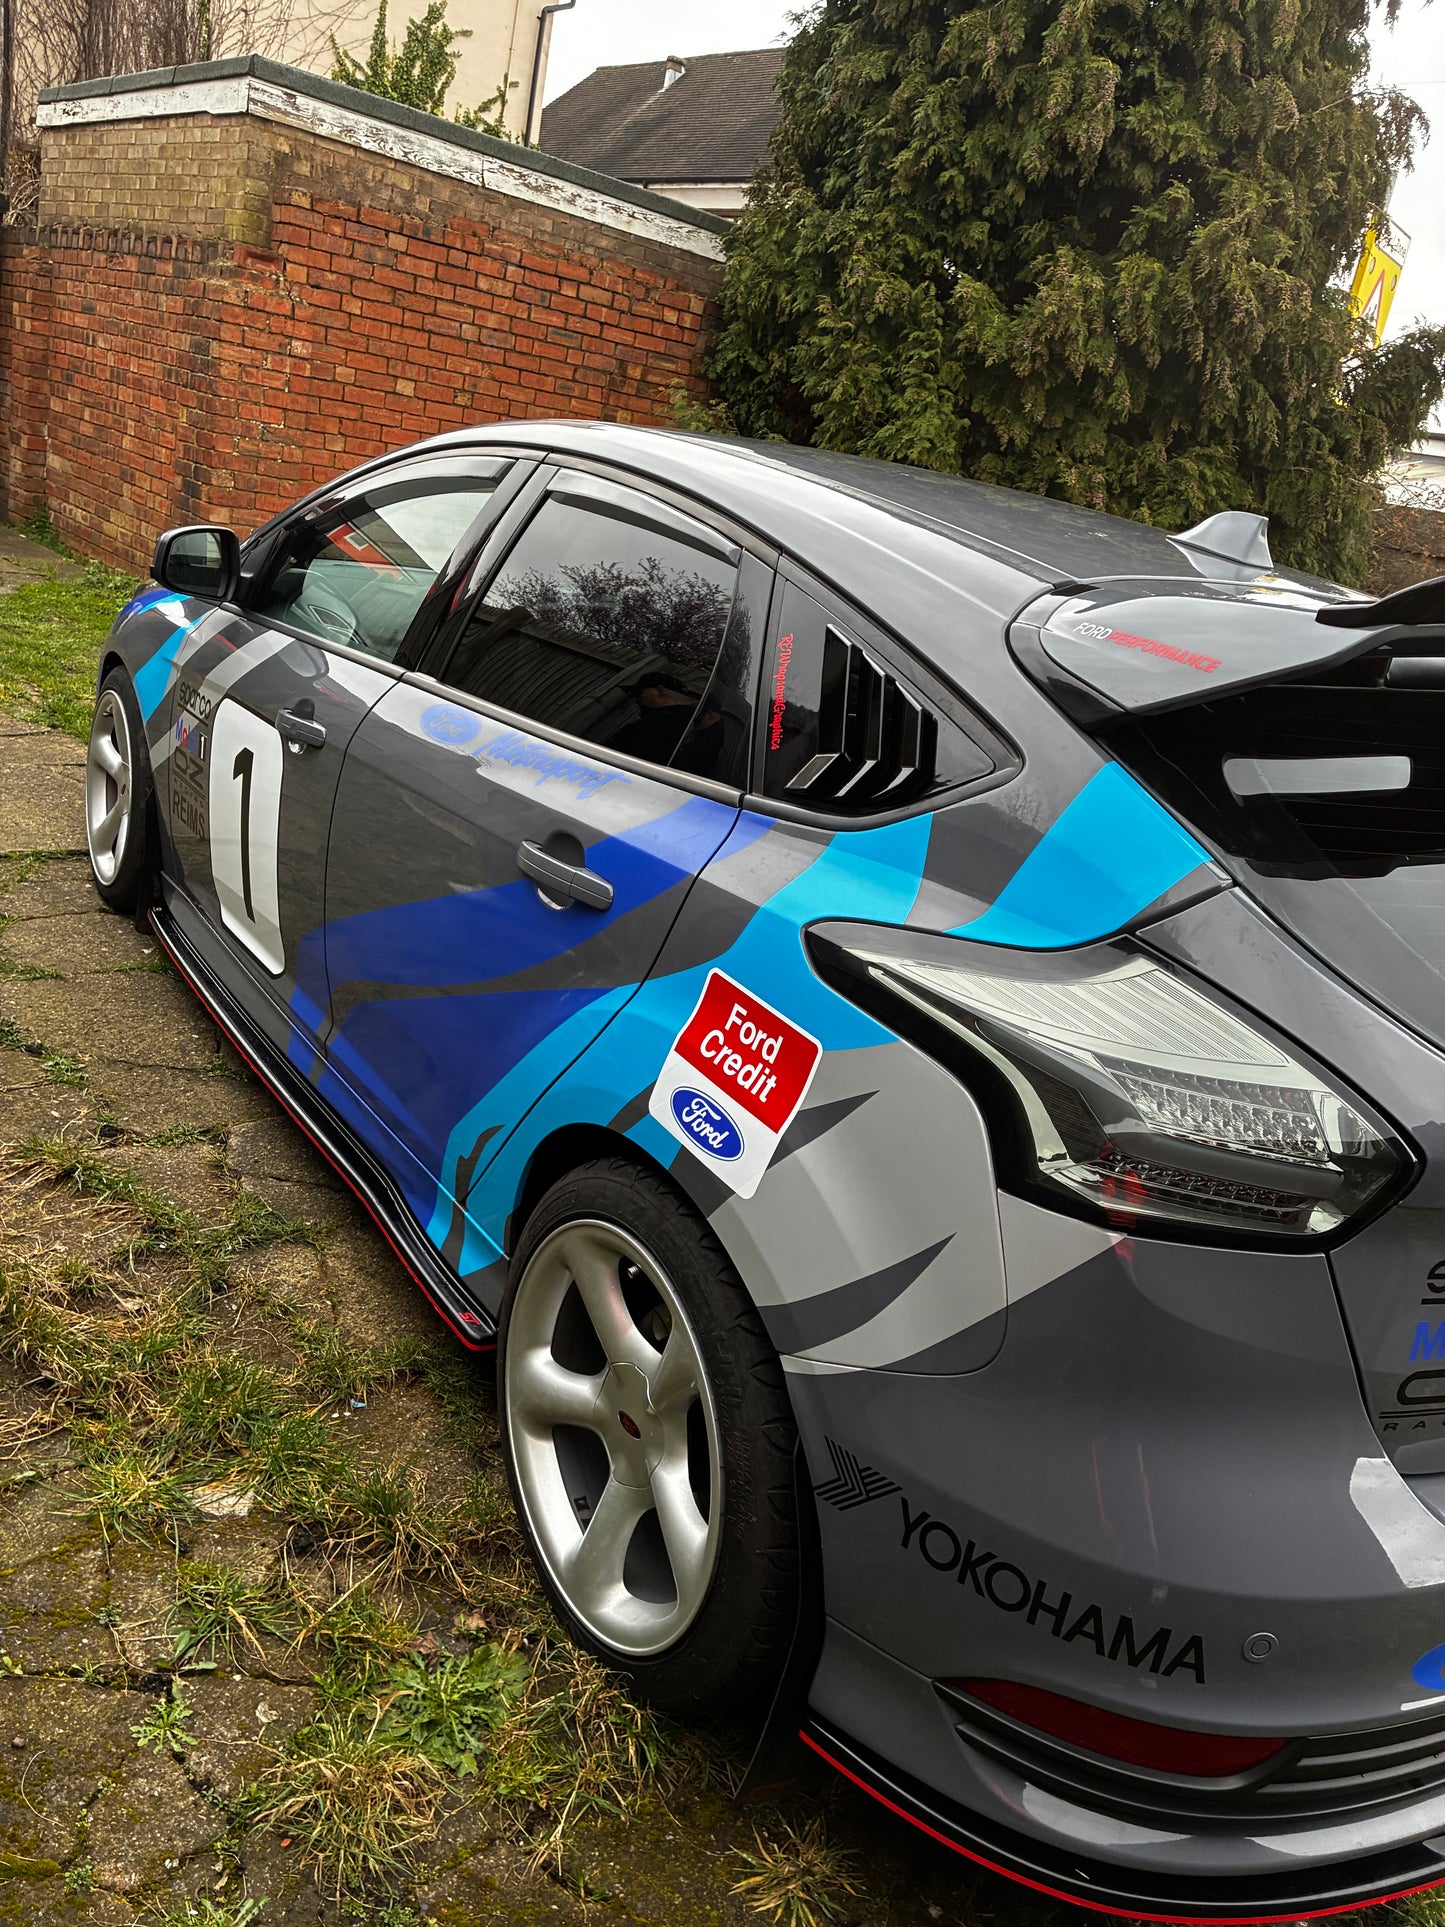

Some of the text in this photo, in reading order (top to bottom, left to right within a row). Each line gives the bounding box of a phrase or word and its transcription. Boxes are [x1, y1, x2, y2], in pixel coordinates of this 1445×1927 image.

[179, 682, 212, 720] sparco
[172, 791, 205, 839] REIMS
[233, 747, 256, 924] 1
[724, 1002, 784, 1064] Ford
[699, 1029, 778, 1103] Credit
[681, 1097, 730, 1149] Ford
[899, 1496, 1207, 1685] YOKOHAMA
